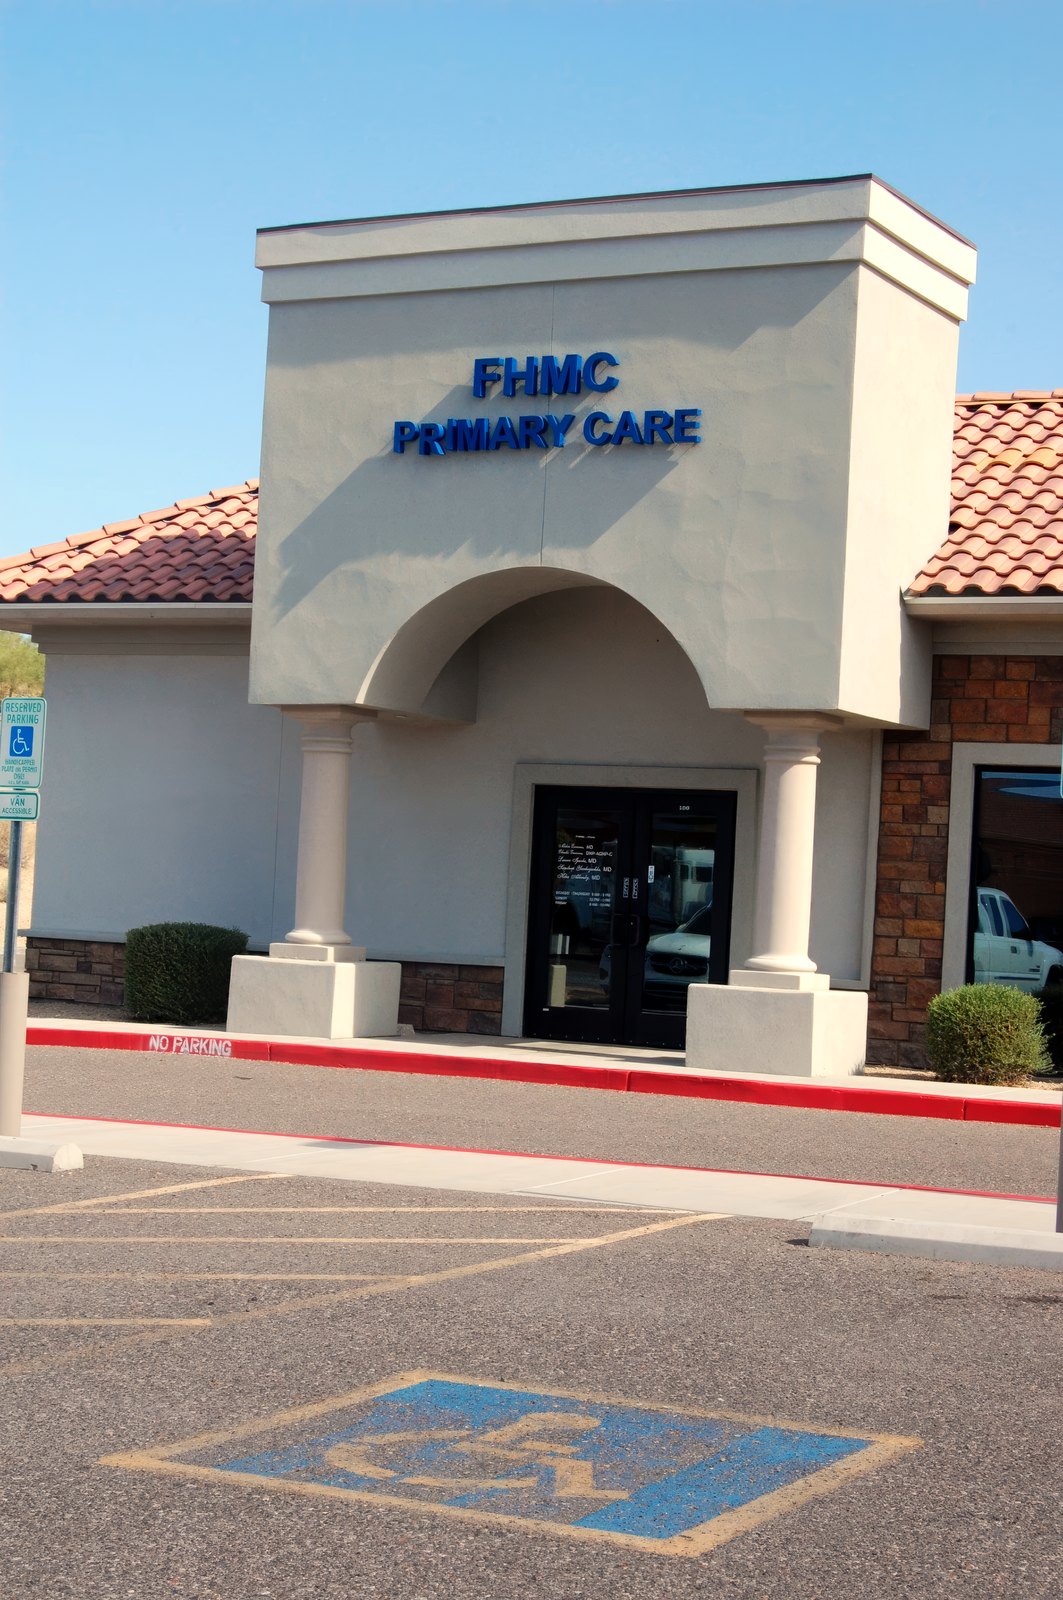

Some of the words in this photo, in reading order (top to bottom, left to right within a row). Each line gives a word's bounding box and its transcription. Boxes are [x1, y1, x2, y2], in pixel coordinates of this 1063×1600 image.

[473, 351, 620, 398] FHMC
[393, 414, 575, 456] PRIMARY
[583, 408, 702, 446] CARE
[6, 703, 41, 712] RESERVED
[7, 714, 39, 724] PARKING
[11, 798, 25, 806] VAN
[149, 1035, 169, 1051] NO
[172, 1036, 232, 1056] PARKING
